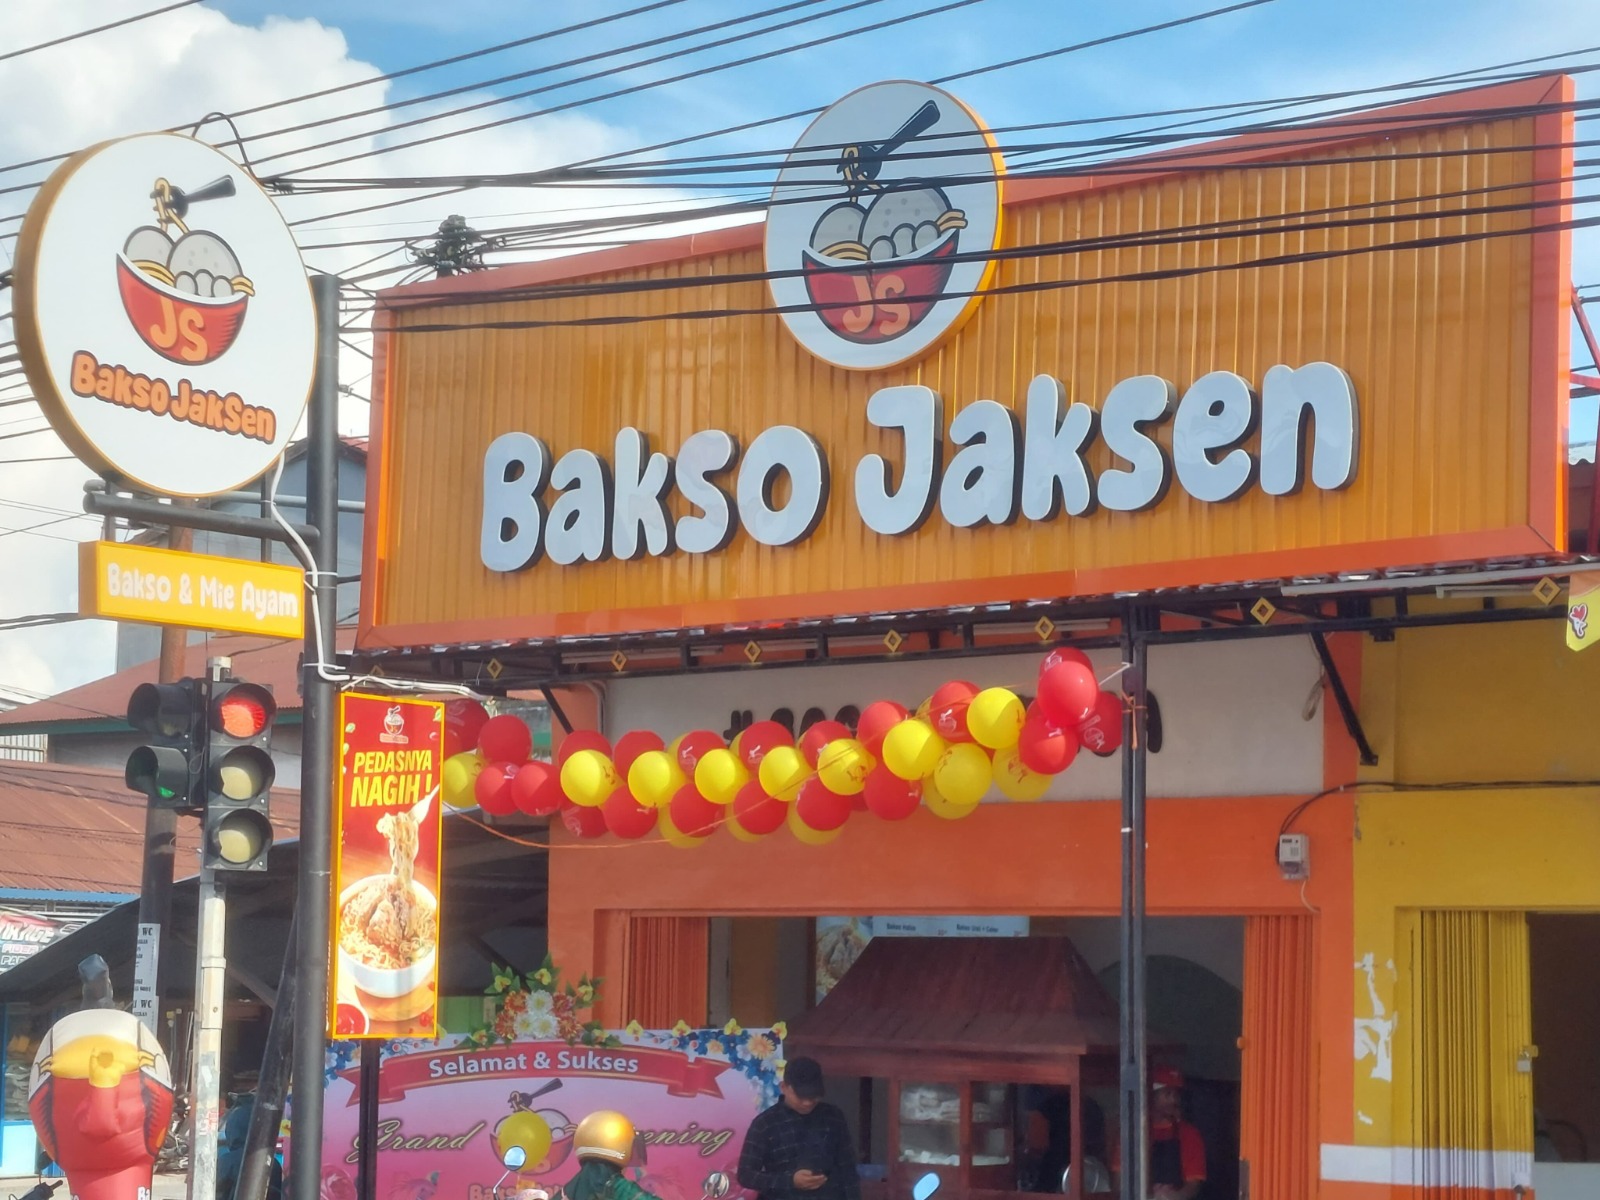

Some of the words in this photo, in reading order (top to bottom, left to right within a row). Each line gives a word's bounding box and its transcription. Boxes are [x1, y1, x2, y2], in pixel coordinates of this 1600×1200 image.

[150, 297, 208, 362] JS
[843, 274, 911, 336] JS
[71, 351, 170, 416] Bakso
[481, 425, 829, 572] Bakso
[855, 361, 1358, 536] Jaksen
[107, 562, 171, 603] Bakso
[178, 573, 193, 605] &
[200, 575, 235, 611] Mie
[241, 580, 299, 620] Ayam
[353, 750, 432, 774] PEDASNYA
[429, 1055, 527, 1078] Selamat
[533, 1051, 550, 1069] &
[557, 1051, 639, 1073] Sukses
[643, 1123, 734, 1156] ening
